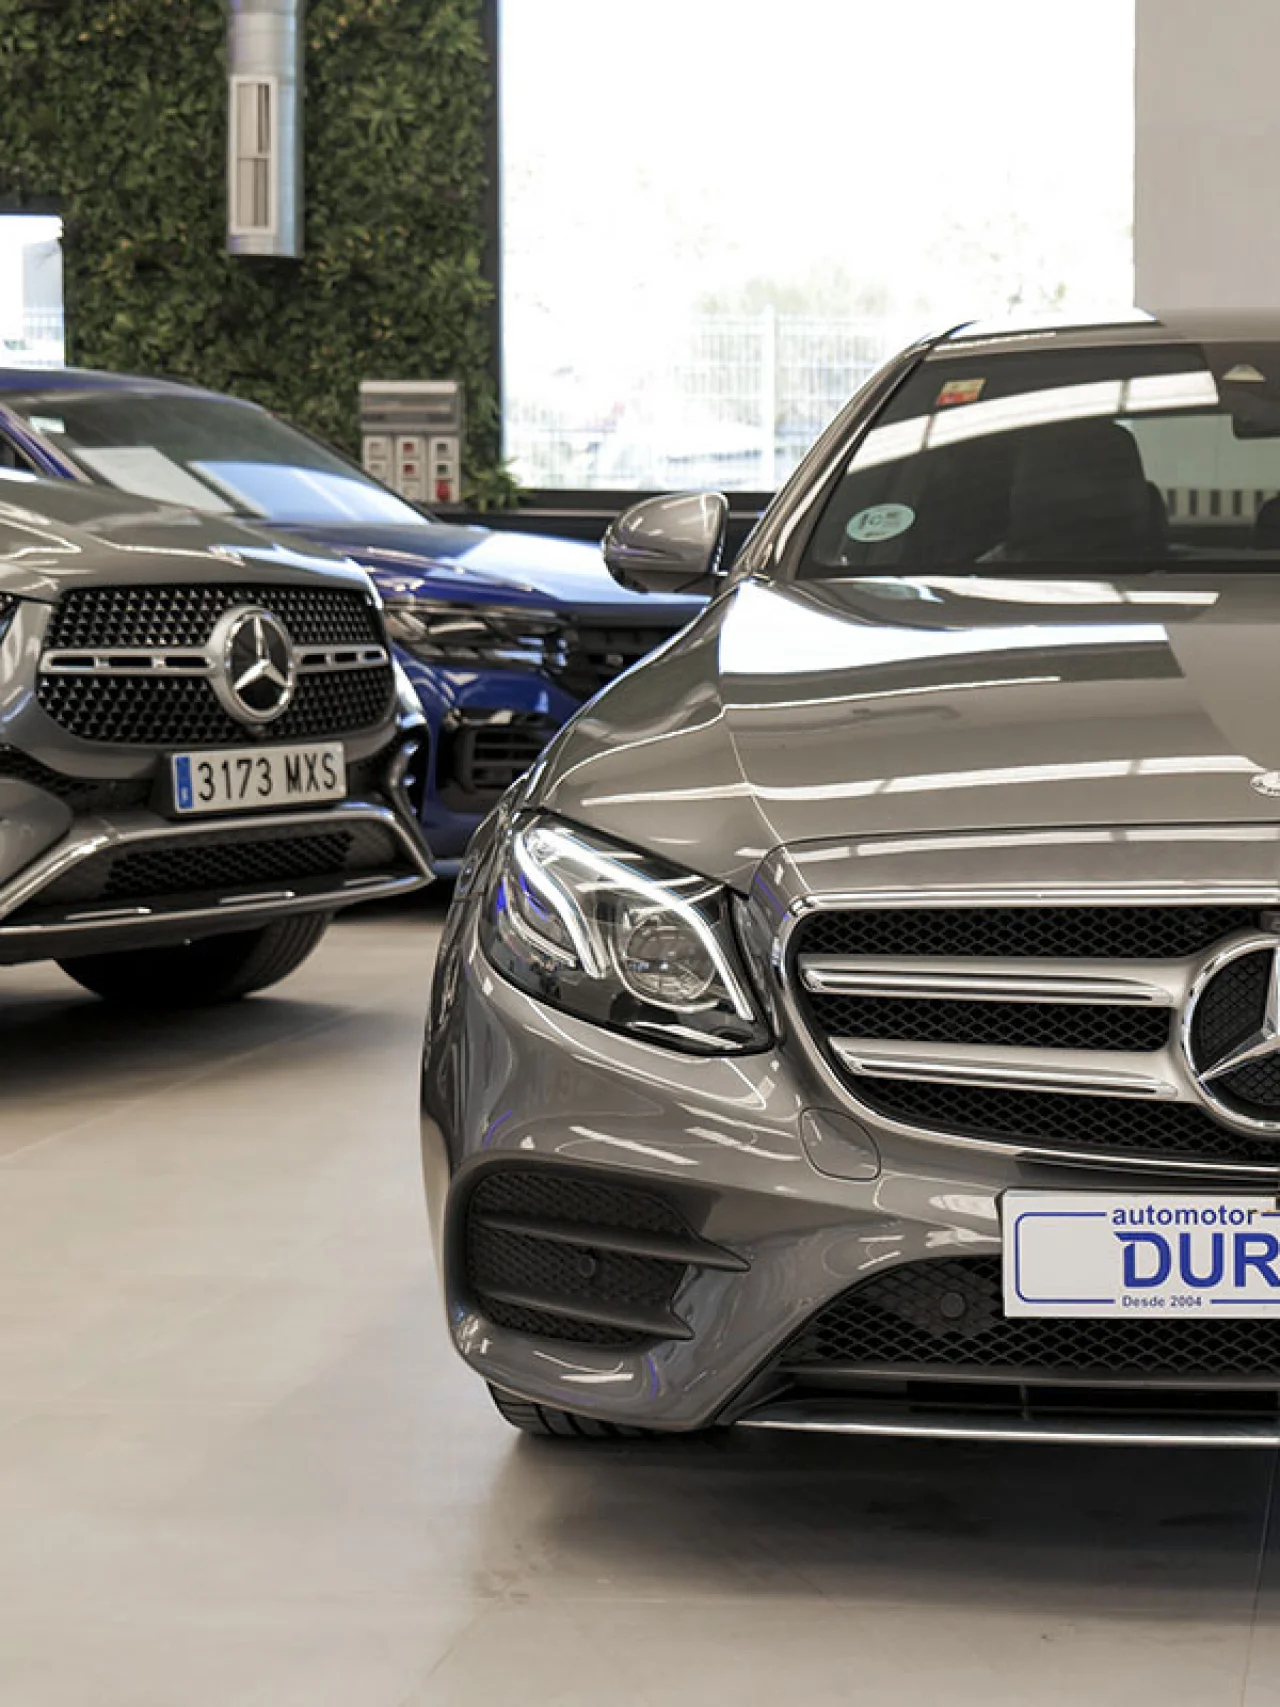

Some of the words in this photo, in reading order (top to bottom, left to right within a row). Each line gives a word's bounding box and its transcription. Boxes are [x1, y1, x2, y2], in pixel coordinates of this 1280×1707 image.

[198, 757, 272, 802] 3173
[285, 752, 337, 793] MXS
[1112, 1205, 1258, 1226] automotor
[1122, 1295, 1165, 1307] Desde
[1170, 1295, 1202, 1307] 2004
